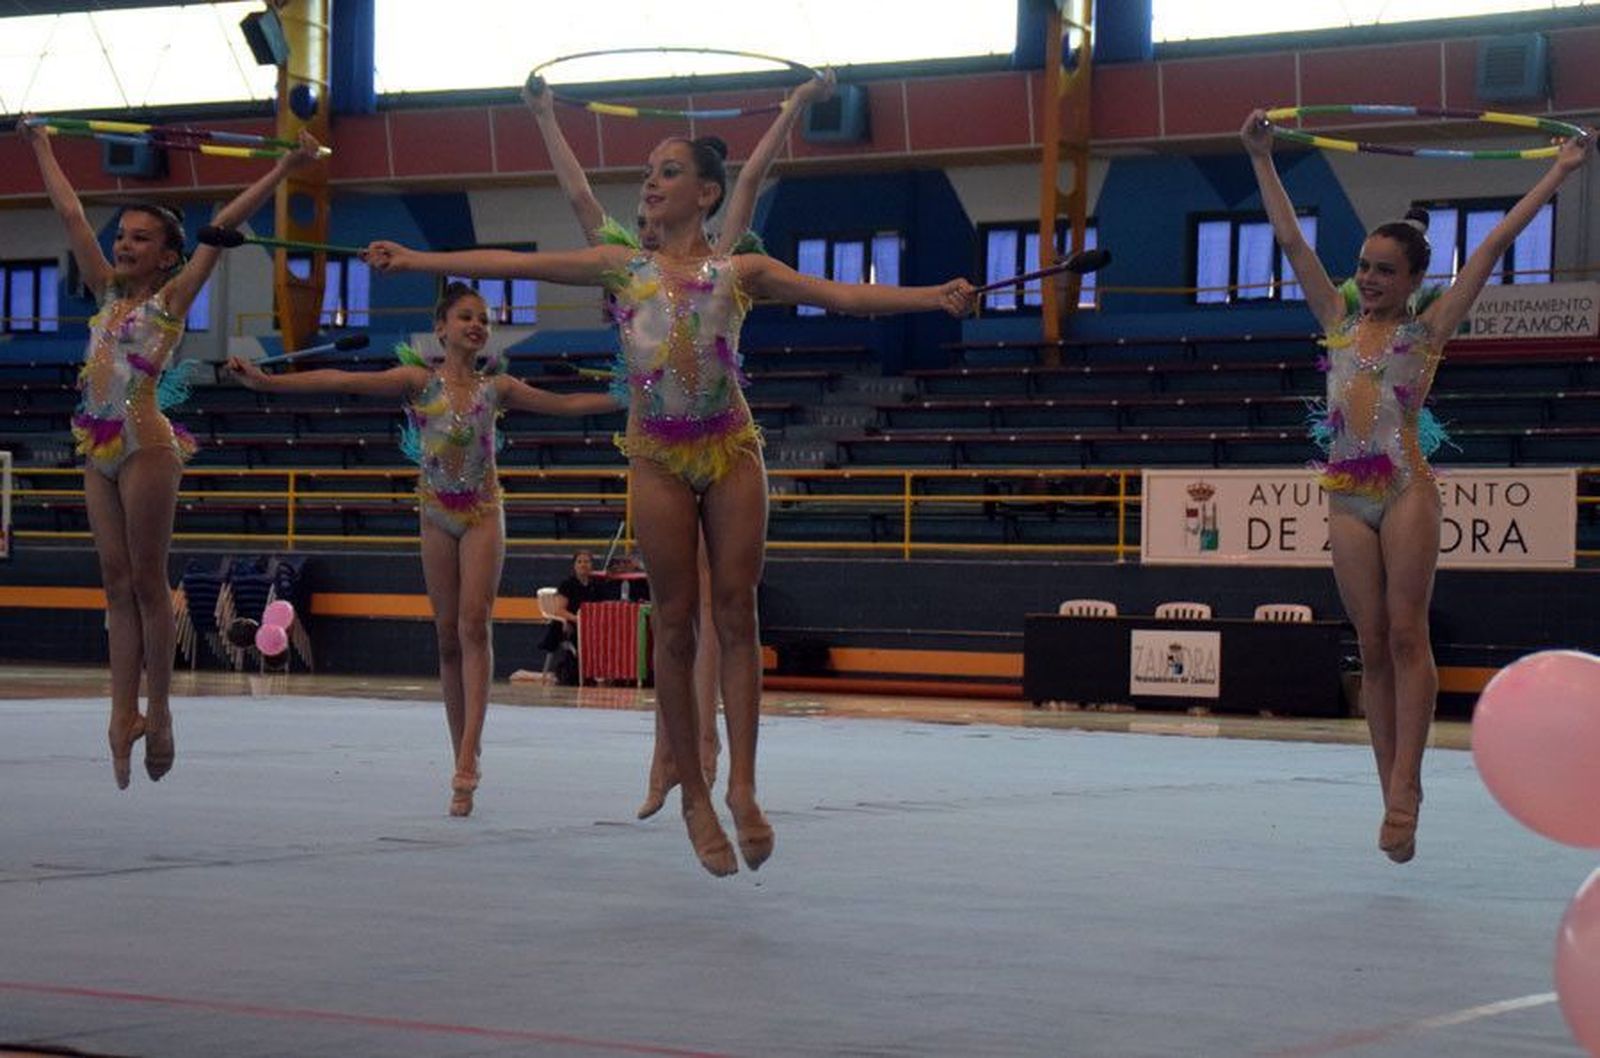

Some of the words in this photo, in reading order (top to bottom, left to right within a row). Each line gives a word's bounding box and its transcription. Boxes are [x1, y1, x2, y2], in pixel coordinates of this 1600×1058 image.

[1476, 298, 1592, 313] AYUNTAMIENTO
[1475, 316, 1497, 334] DE
[1503, 315, 1590, 333] ZAMORA
[1249, 483, 1530, 507] AYUENTO
[1248, 517, 1296, 551] DE
[1323, 517, 1528, 553] ORA
